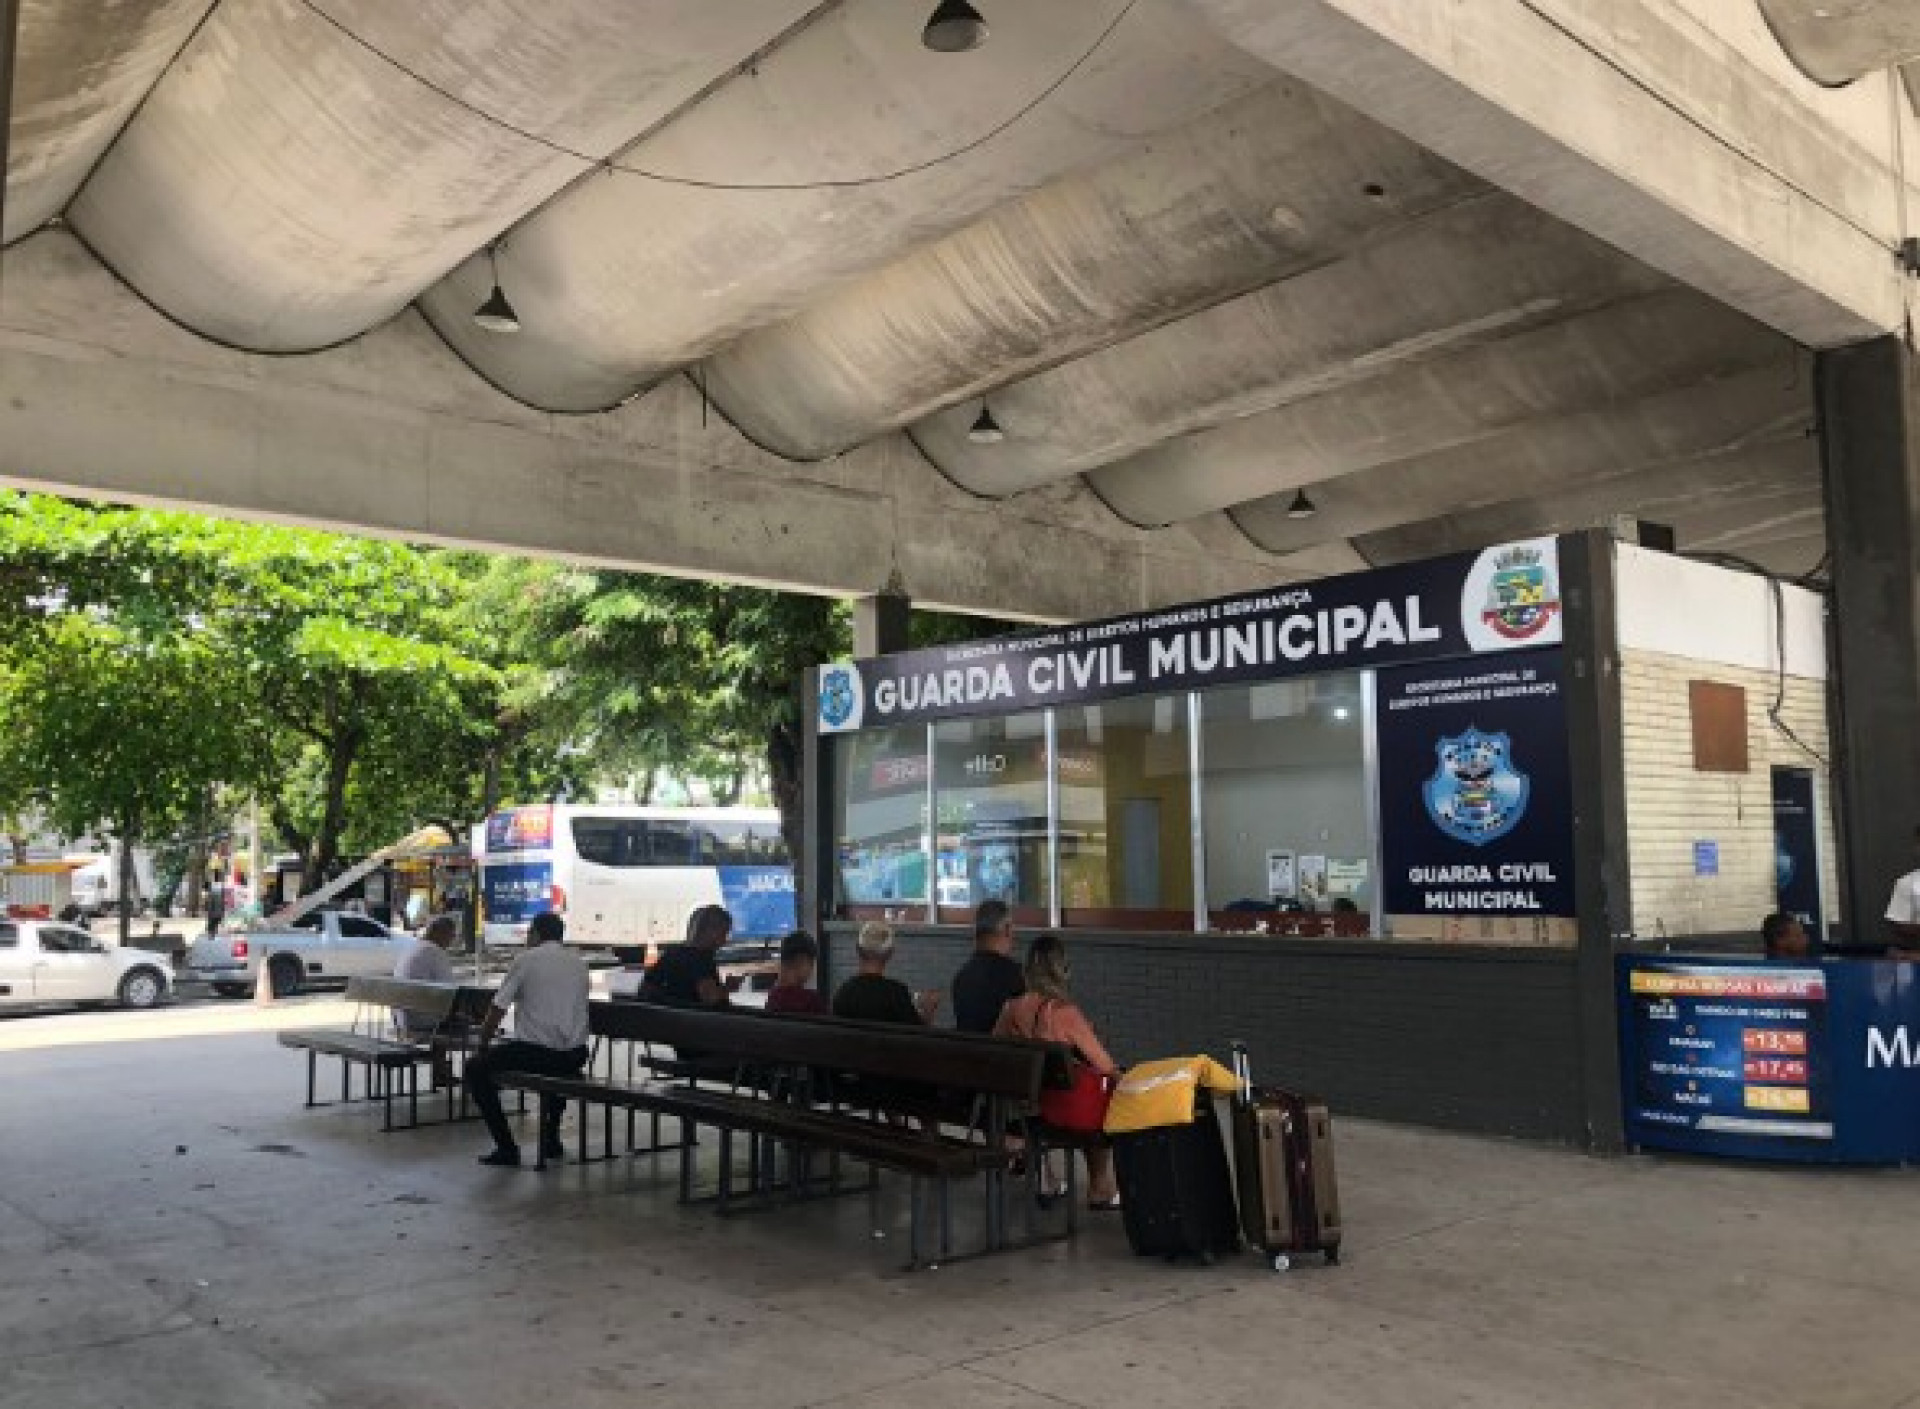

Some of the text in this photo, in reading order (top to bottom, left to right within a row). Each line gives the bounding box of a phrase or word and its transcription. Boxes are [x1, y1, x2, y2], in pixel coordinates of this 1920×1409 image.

[874, 595, 1440, 714] GUARDA CIVIL MUNICIPAL
[1408, 861, 1556, 883] GUARDA CIVIL
[1424, 889, 1542, 909] MUNICIPAL
